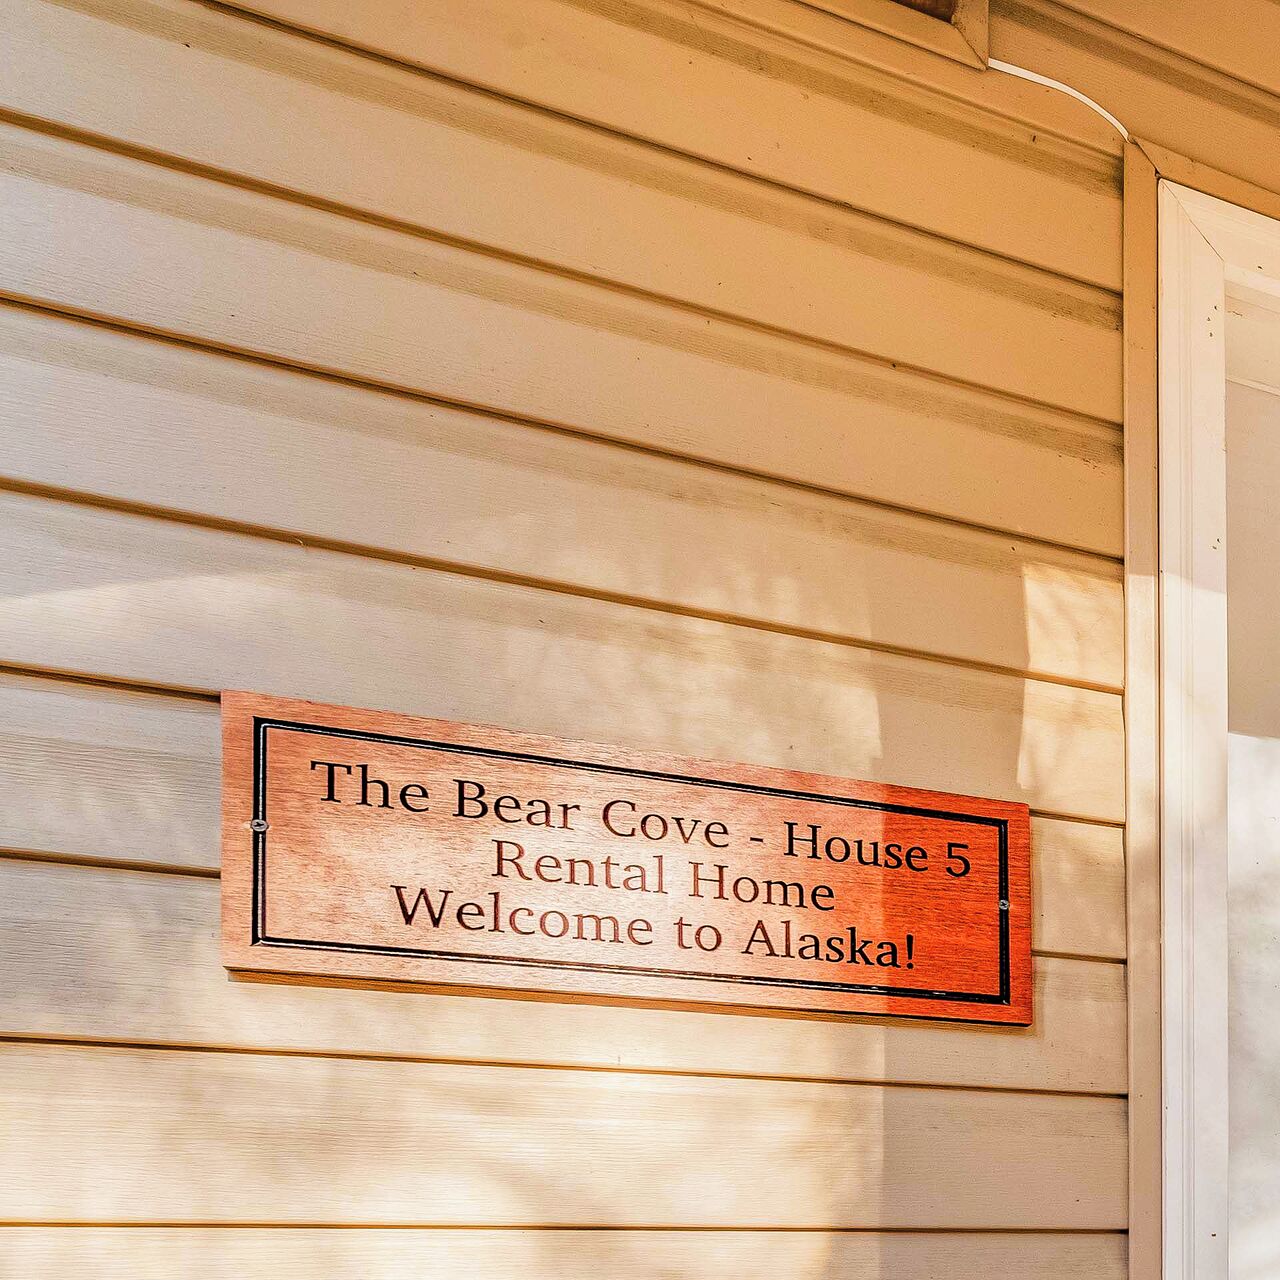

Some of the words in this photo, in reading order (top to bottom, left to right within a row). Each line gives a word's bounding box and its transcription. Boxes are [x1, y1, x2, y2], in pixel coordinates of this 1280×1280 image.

[310, 761, 430, 813] The
[452, 778, 581, 831] Bear
[602, 799, 730, 848] Cove
[783, 820, 929, 873] House
[945, 841, 971, 878] 5
[490, 838, 669, 896] Rental
[687, 861, 836, 913] Home
[389, 884, 654, 947] Welcome
[673, 916, 723, 952] to
[740, 919, 916, 969] Alaska!
